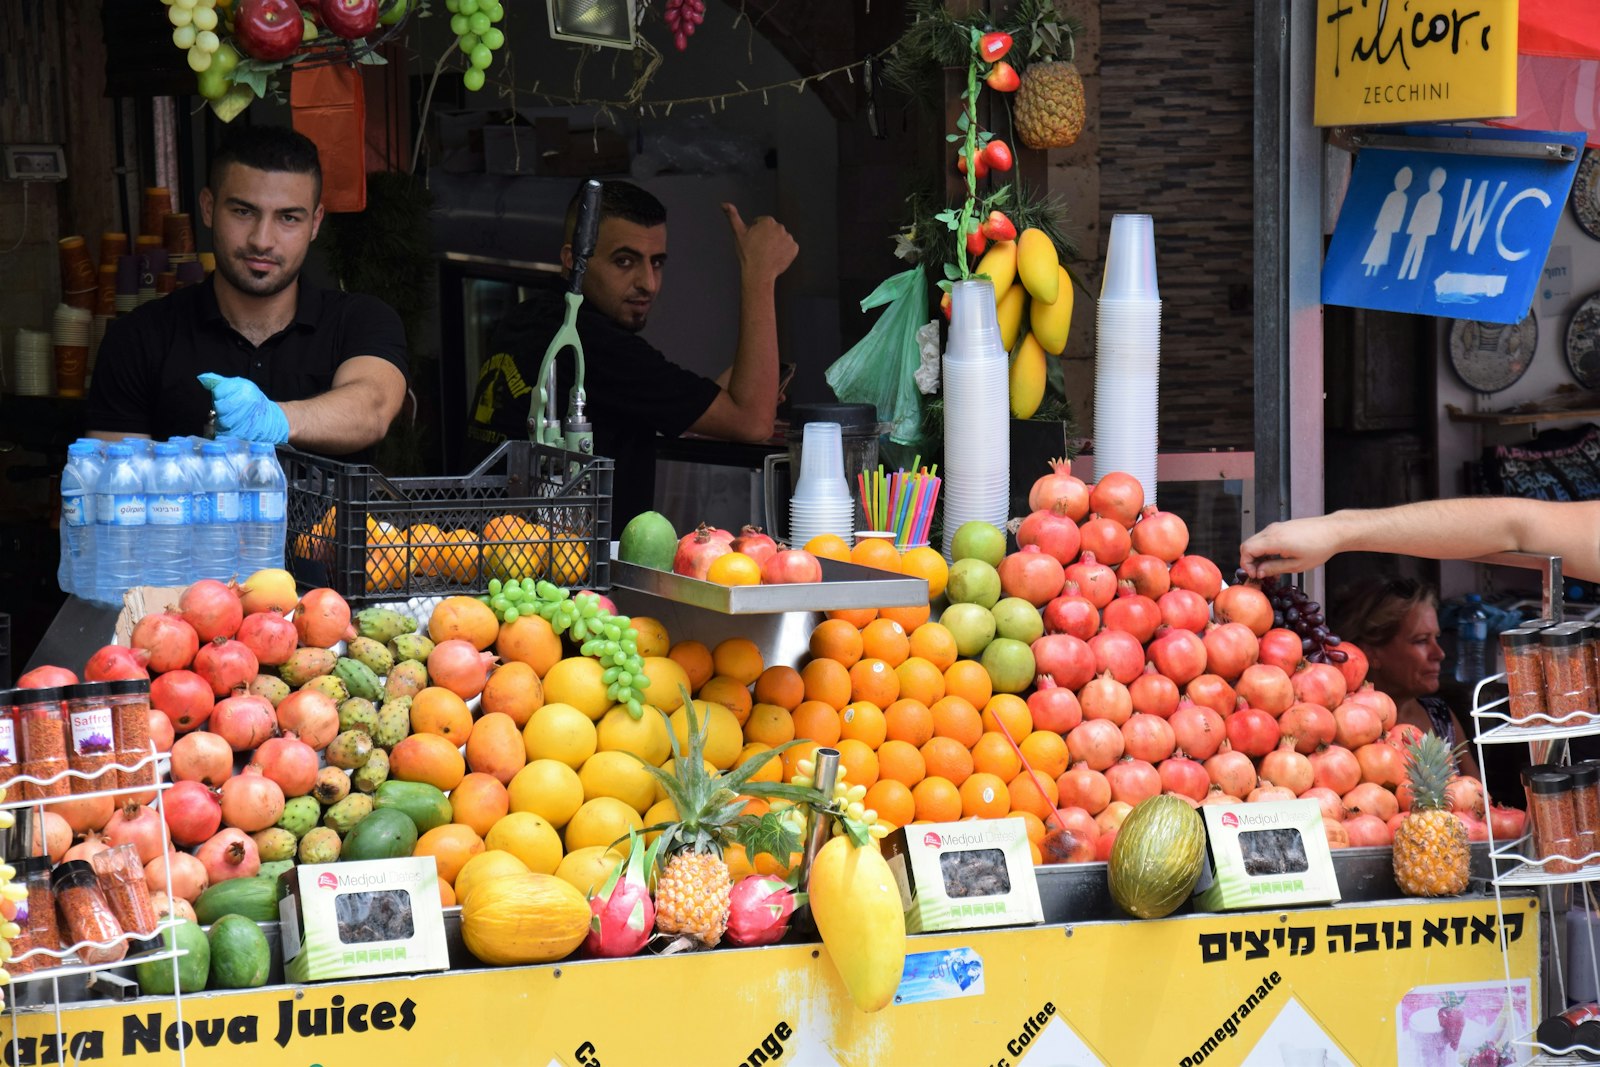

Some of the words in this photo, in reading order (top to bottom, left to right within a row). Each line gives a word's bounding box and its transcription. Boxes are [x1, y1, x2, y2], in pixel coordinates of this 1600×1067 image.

[1364, 82, 1450, 104] ZECCHINI
[1450, 178, 1552, 261] WC
[1238, 812, 1280, 826] Medjoul
[941, 833, 984, 847] Medjoul
[338, 871, 387, 887] Medjoul
[1198, 926, 1316, 964] מיצים
[1326, 919, 1412, 954] נובה
[1422, 912, 1525, 953] קאזא
[0, 1029, 104, 1067] aza
[122, 1012, 258, 1056] Nova
[273, 994, 417, 1049] Juices
[1006, 1001, 1056, 1058] Coffee
[1179, 971, 1282, 1067] Pomegranate
